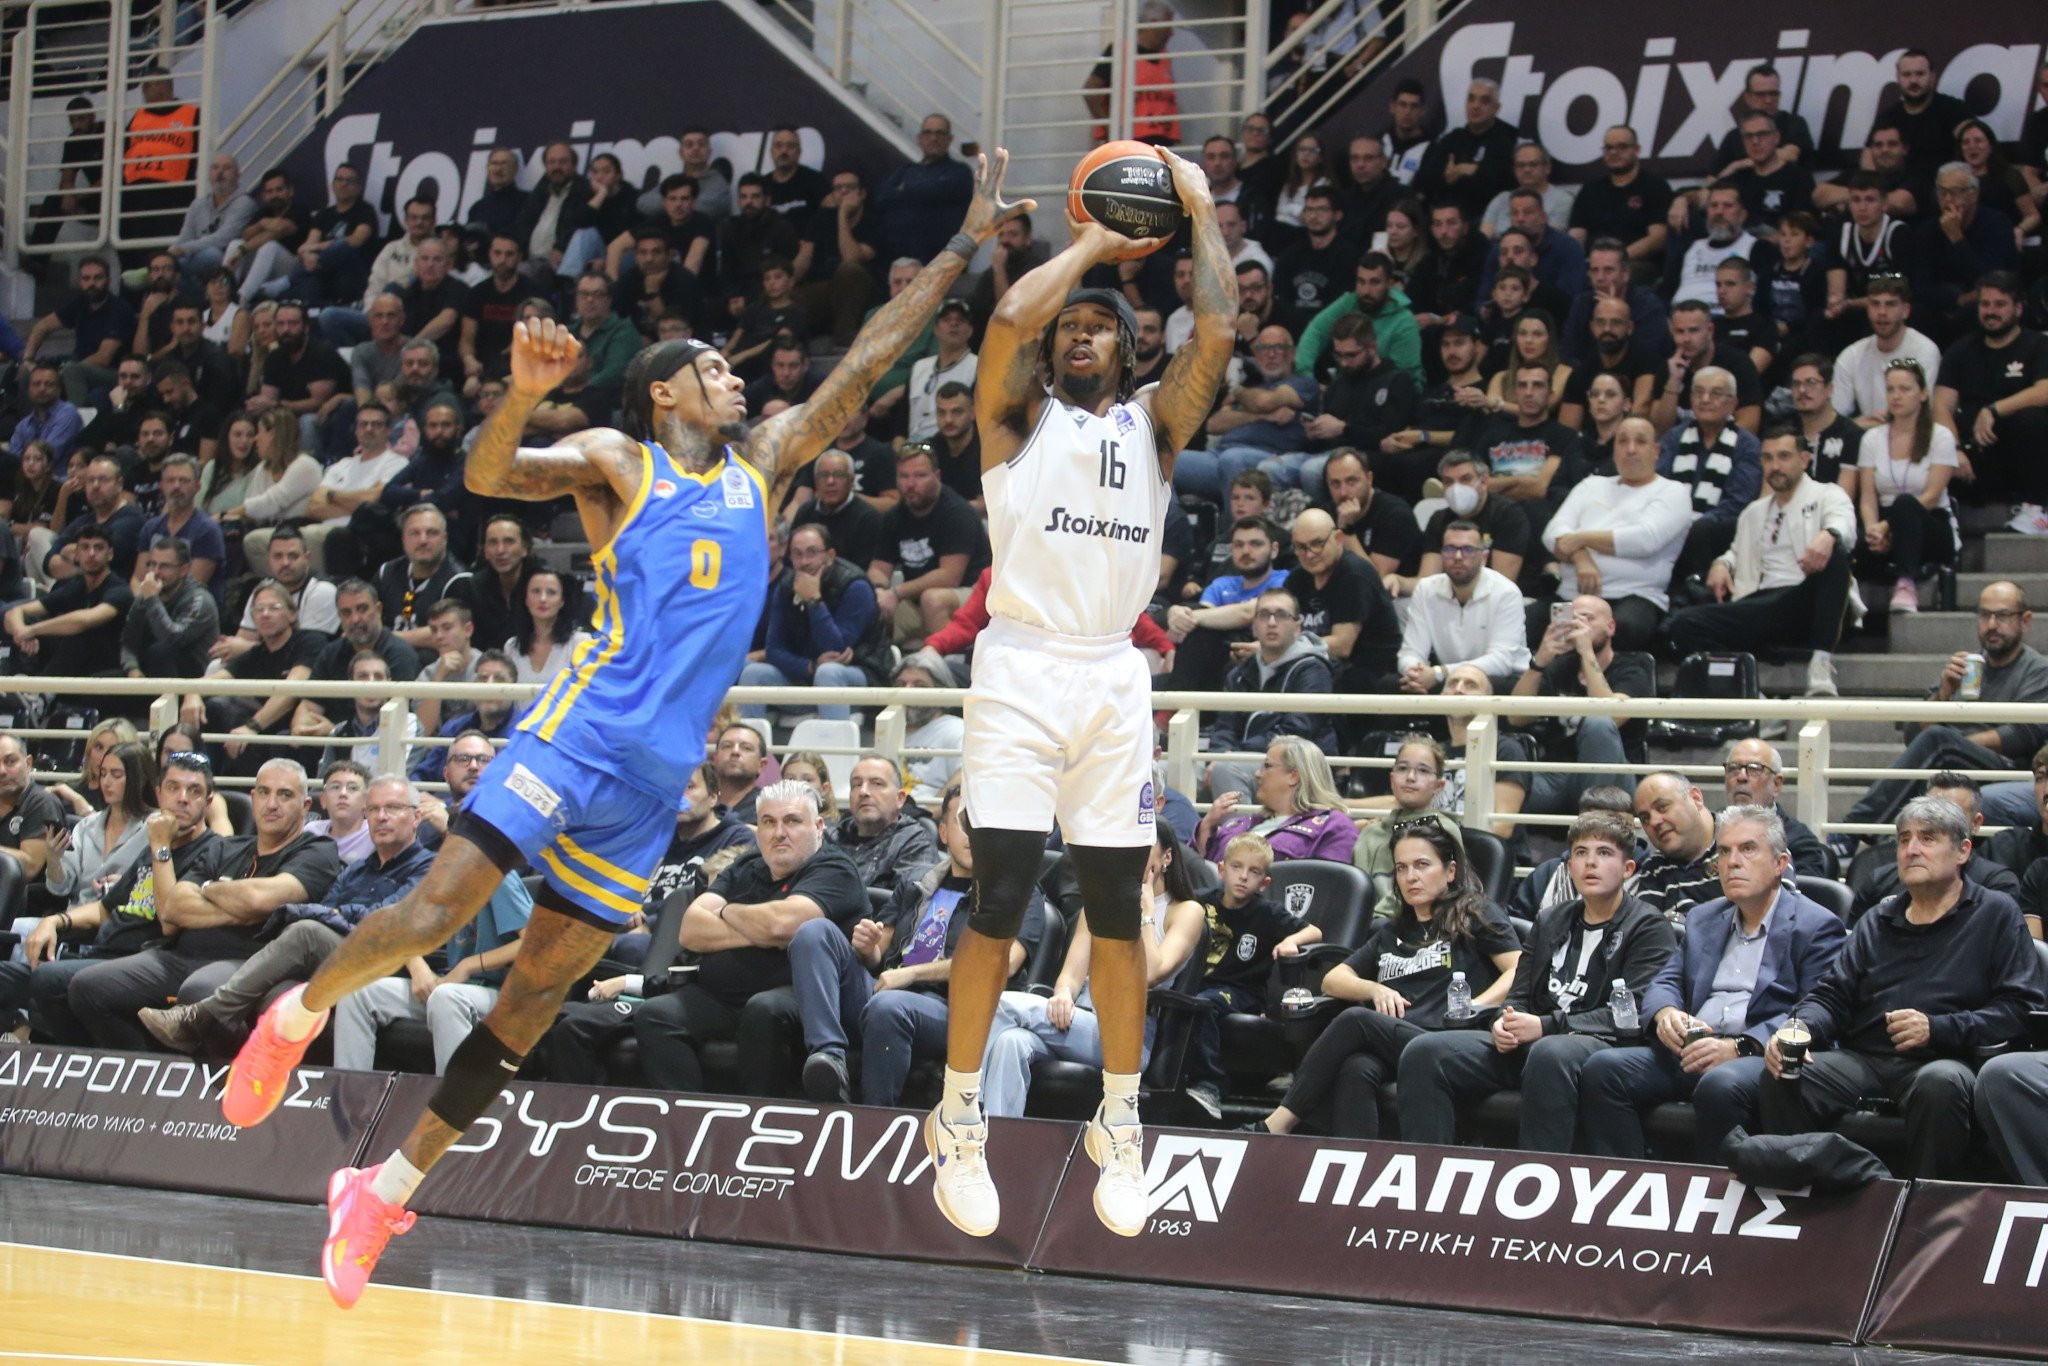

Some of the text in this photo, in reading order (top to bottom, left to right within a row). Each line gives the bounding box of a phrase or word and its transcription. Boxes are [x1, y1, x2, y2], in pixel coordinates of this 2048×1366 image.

[1439, 21, 2048, 166] Stoixima
[1100, 439, 1126, 489] 16
[689, 538, 722, 591] 0
[0, 1050, 325, 1109] ΔΗΡΟΠΟΥΣ
[0, 1107, 99, 1130] ΕΚΤΡΟΛΟΓΙΚΟ
[103, 1116, 145, 1133] ΥΛΙΚΟ
[162, 1121, 242, 1142] ΦΩΤΙΣΜΟΣ
[447, 1089, 936, 1186] SYSTEM
[574, 1164, 795, 1201] OFFICE CONCEPT
[1298, 1148, 1812, 1240] ΠΑΠΟΥΔΗΣ
[1149, 1218, 1192, 1237] 1963
[1346, 1226, 1713, 1277] ΙΑΤΡΙΚΗ ΤΕΧΝΟΛΟΓΙΑ
